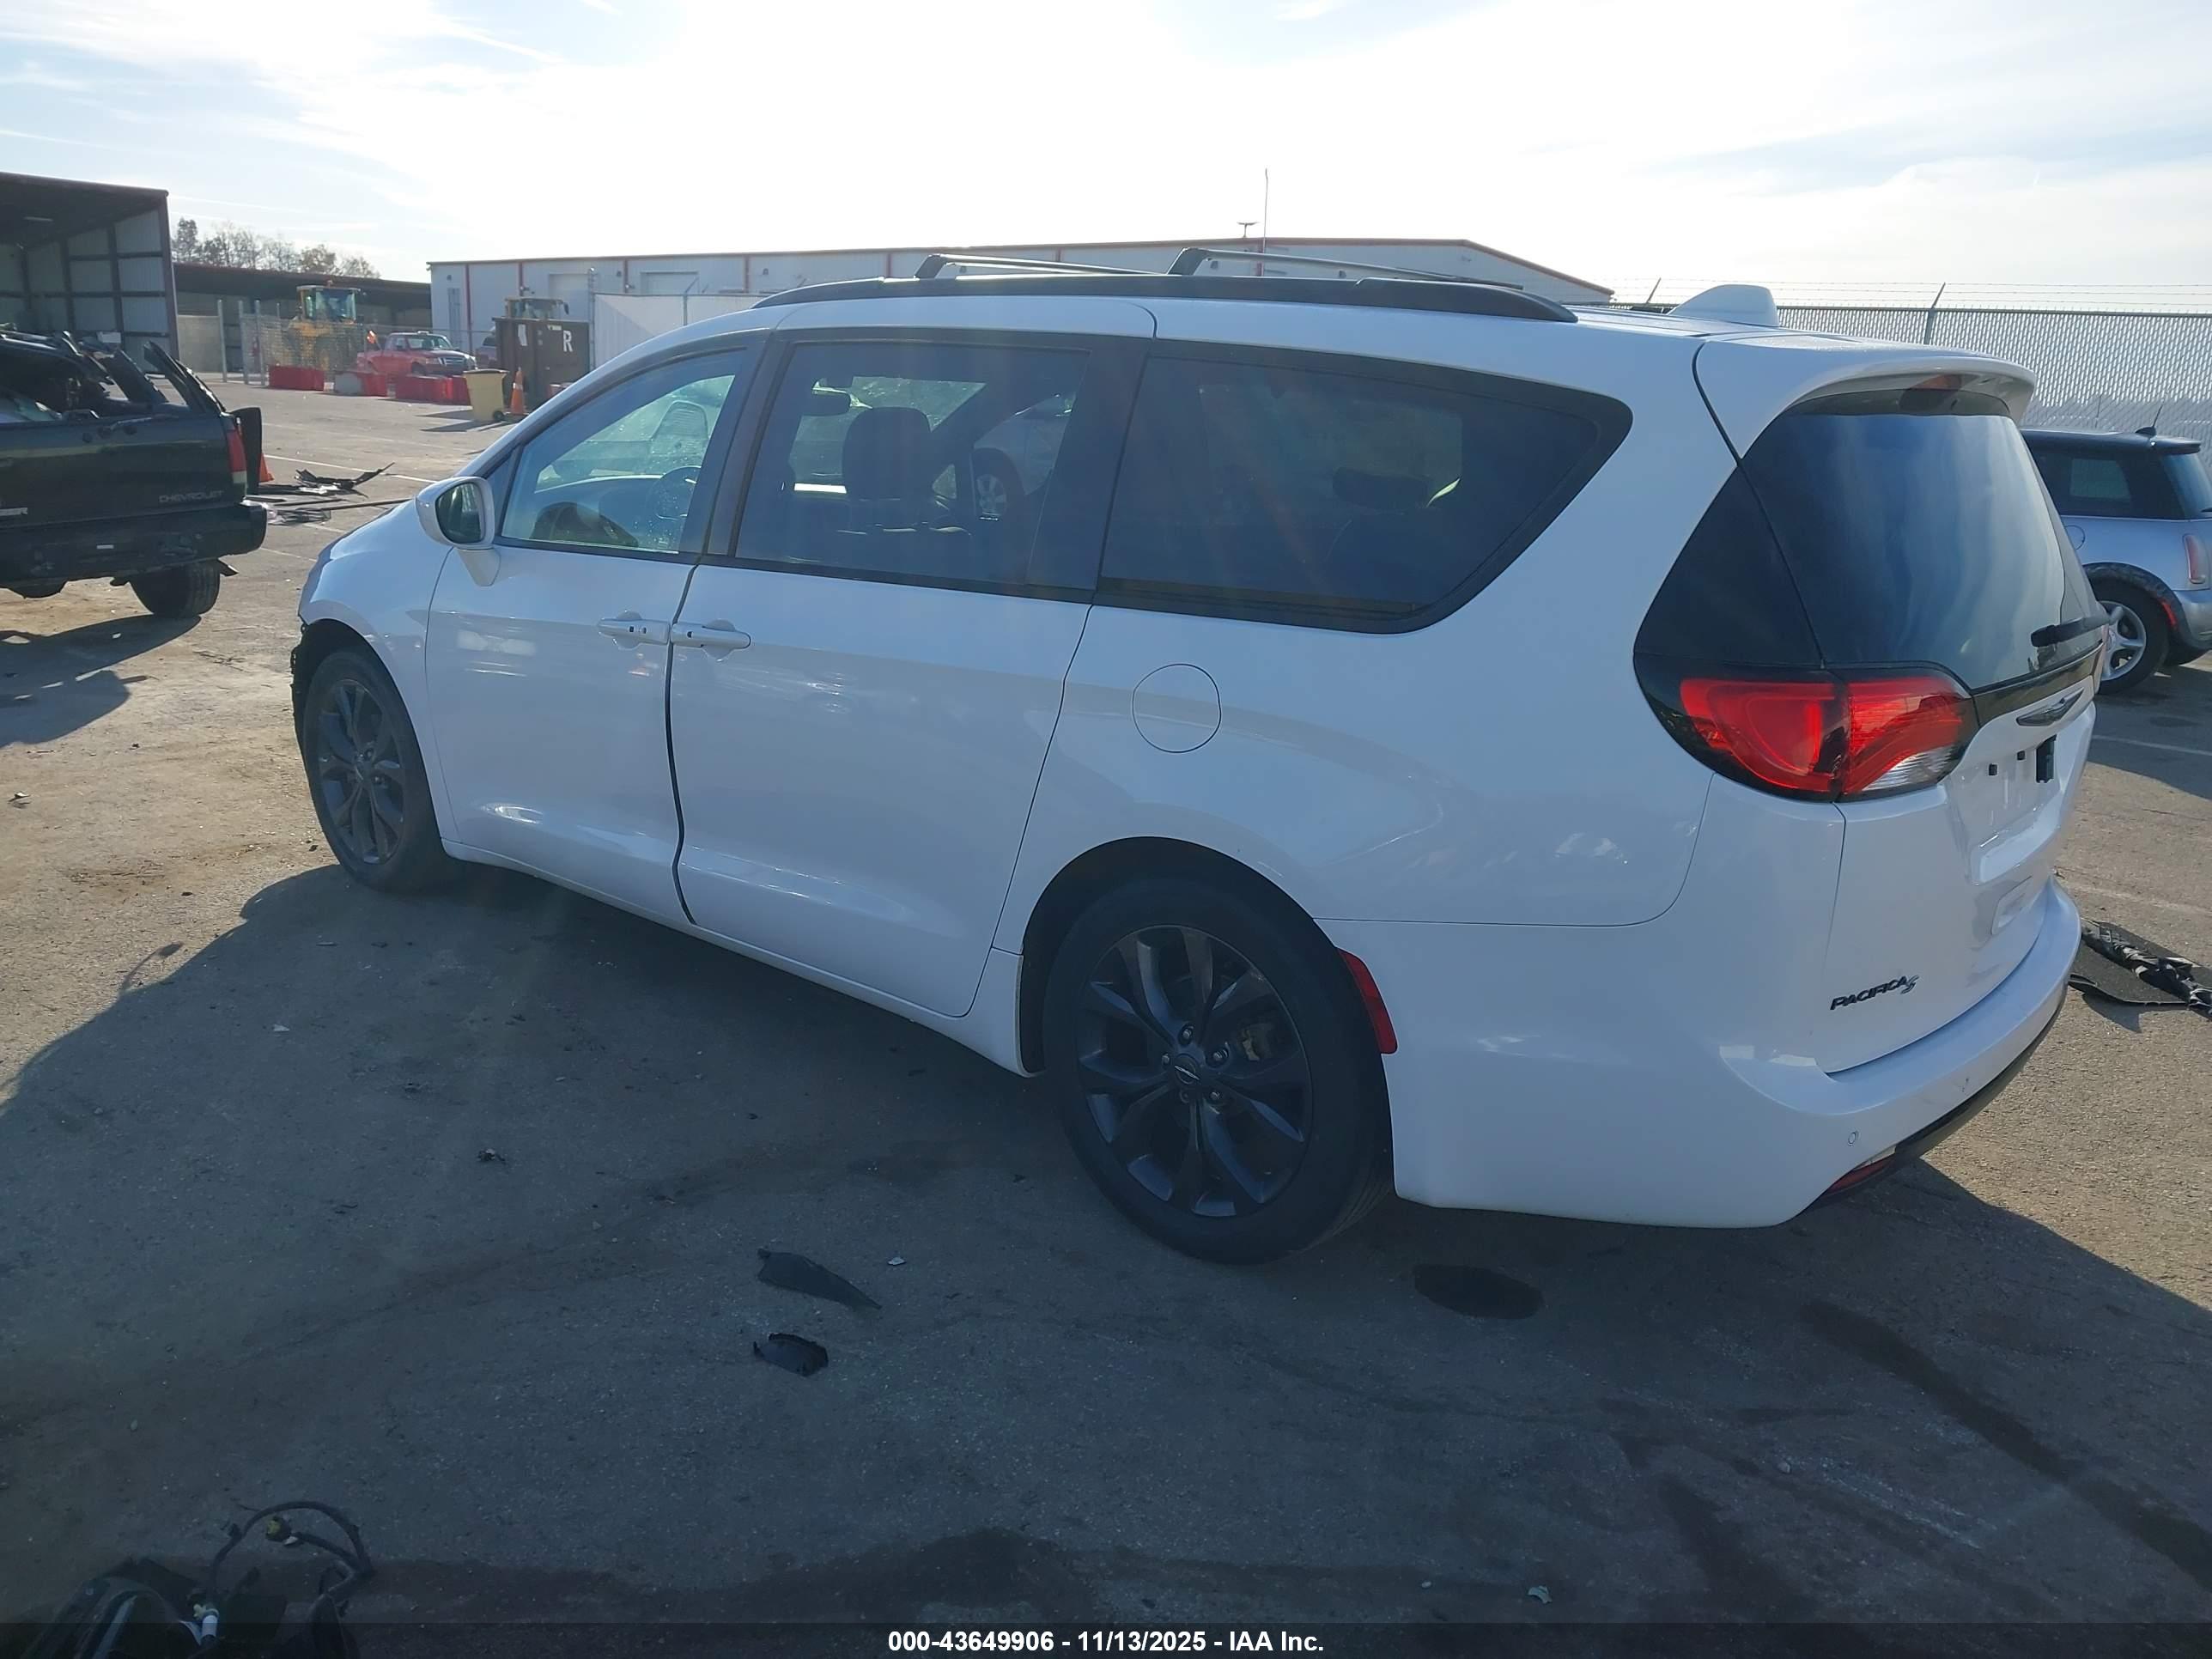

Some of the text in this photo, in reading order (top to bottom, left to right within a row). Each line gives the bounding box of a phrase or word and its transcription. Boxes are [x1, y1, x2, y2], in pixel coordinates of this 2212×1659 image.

[562, 330, 574, 352] R
[158, 490, 225, 503] CHEVROLET
[1830, 975, 1907, 1010] PACIFICA
